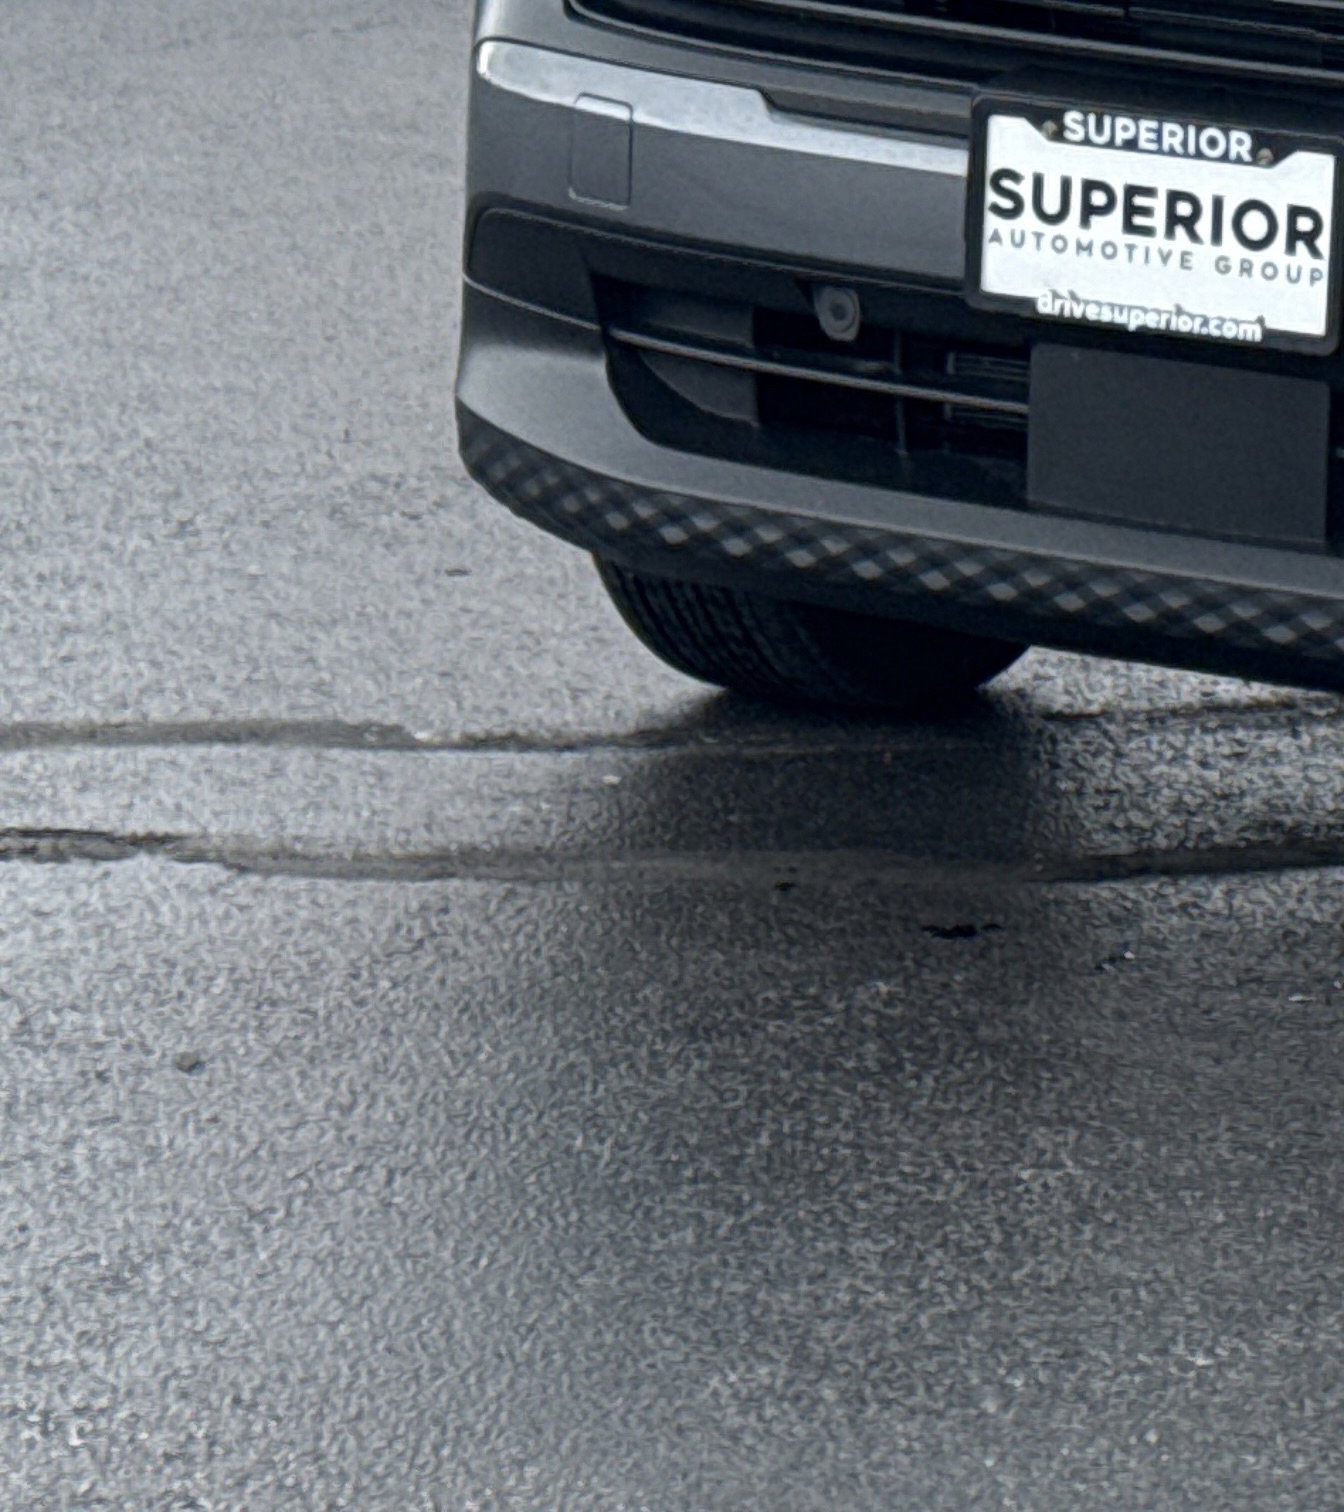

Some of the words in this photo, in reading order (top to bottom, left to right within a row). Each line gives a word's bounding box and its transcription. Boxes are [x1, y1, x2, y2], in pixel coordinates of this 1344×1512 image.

[1062, 109, 1253, 163] SUPERIOR
[987, 167, 1324, 260] SUPERIOR
[987, 228, 1194, 271] AUTOMOTIVE
[1213, 254, 1325, 287] GROUP
[1036, 288, 1263, 342] drivesuperior.com
